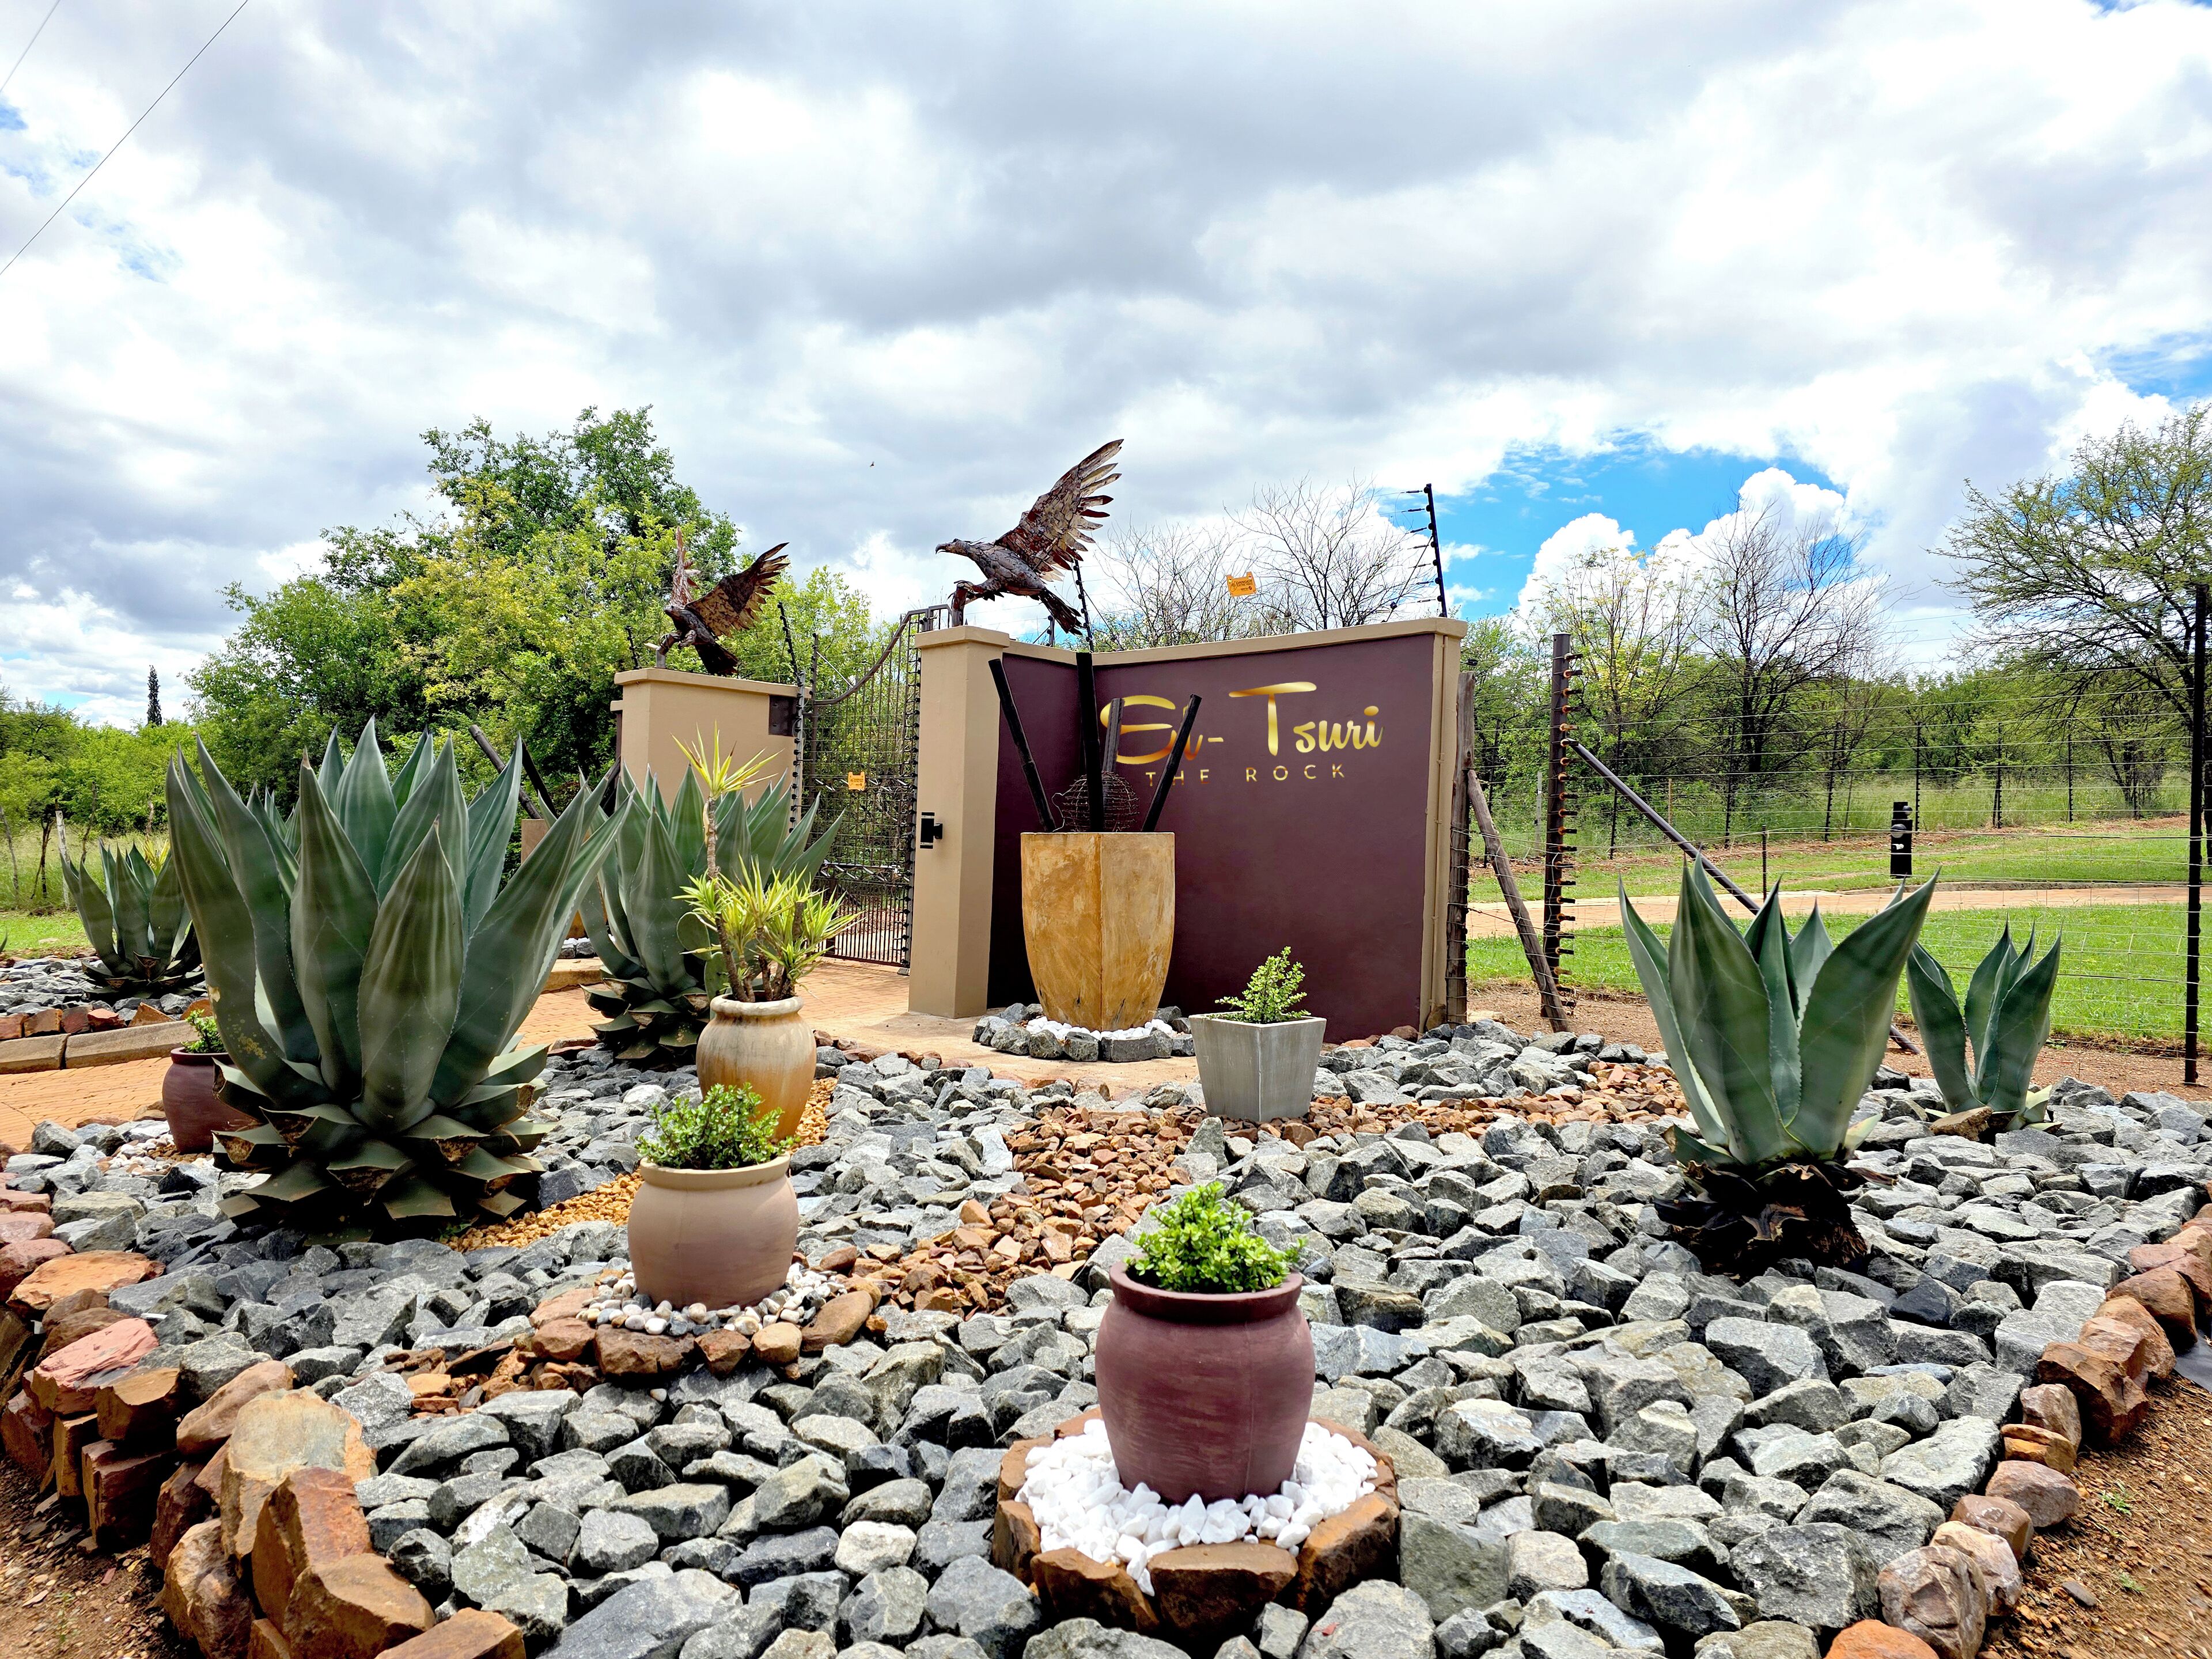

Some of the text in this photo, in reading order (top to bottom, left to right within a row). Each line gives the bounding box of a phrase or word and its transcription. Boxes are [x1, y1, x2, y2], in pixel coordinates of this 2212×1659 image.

[1228, 681, 1384, 756] Tsuri
[1145, 763, 1345, 787] THE ROCK
